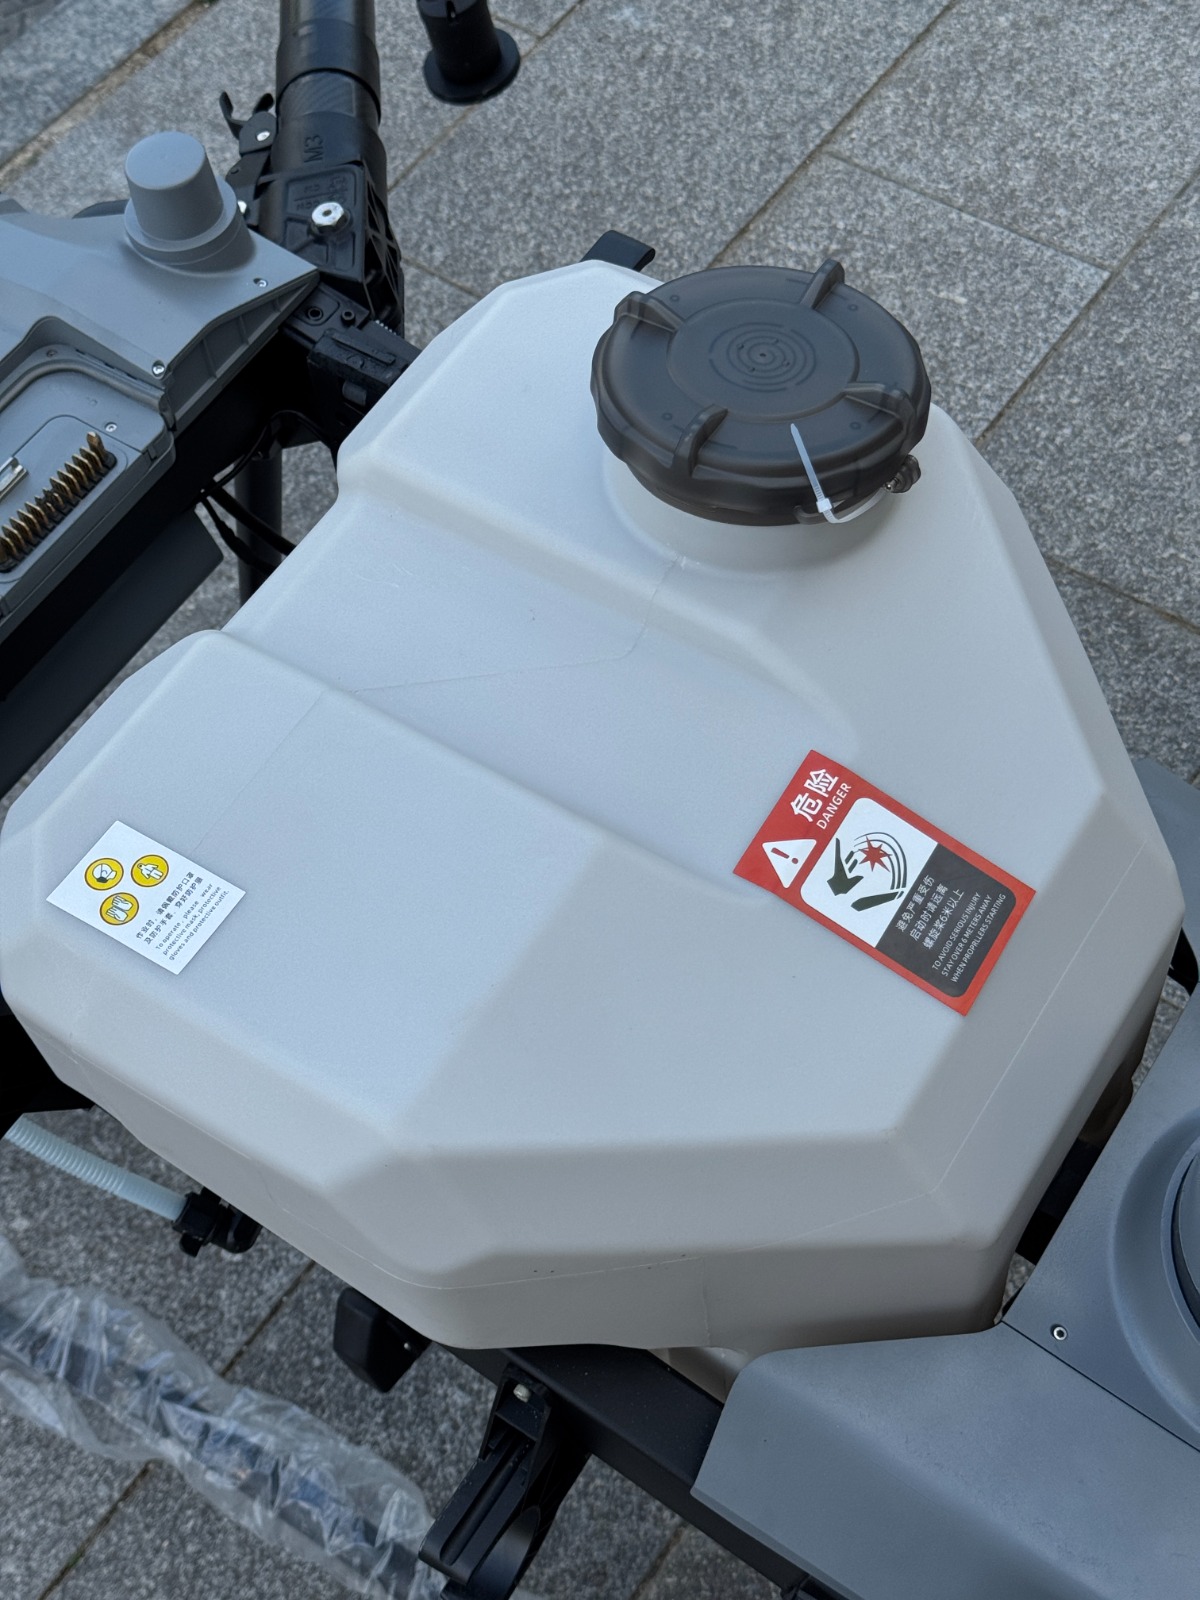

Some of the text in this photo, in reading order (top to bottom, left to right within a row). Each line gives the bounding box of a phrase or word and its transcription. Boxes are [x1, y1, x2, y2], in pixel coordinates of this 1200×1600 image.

[303, 134, 323, 162] M3
[790, 768, 839, 823] 危险
[816, 782, 852, 830] DANGER
[154, 942, 164, 950] To
[182, 900, 200, 920] please
[199, 883, 213, 898] wear
[162, 928, 187, 956] protective
[197, 886, 222, 915] protective
[168, 942, 186, 961] gloves
[183, 931, 195, 944] and
[192, 905, 217, 934] protective
[895, 874, 935, 933] 避免严重受伤
[909, 883, 949, 942] 启动时请远离
[922, 889, 965, 950] 螺旋桨6米以上
[931, 891, 981, 970] TO AVOID SERIOUS INJURY
[941, 958, 955, 977] STAY
[950, 942, 965, 961] OVER
[963, 912, 982, 939] METERS
[978, 894, 992, 915] AWAY
[950, 961, 967, 983] WHEN
[984, 893, 1007, 925] STARTING
